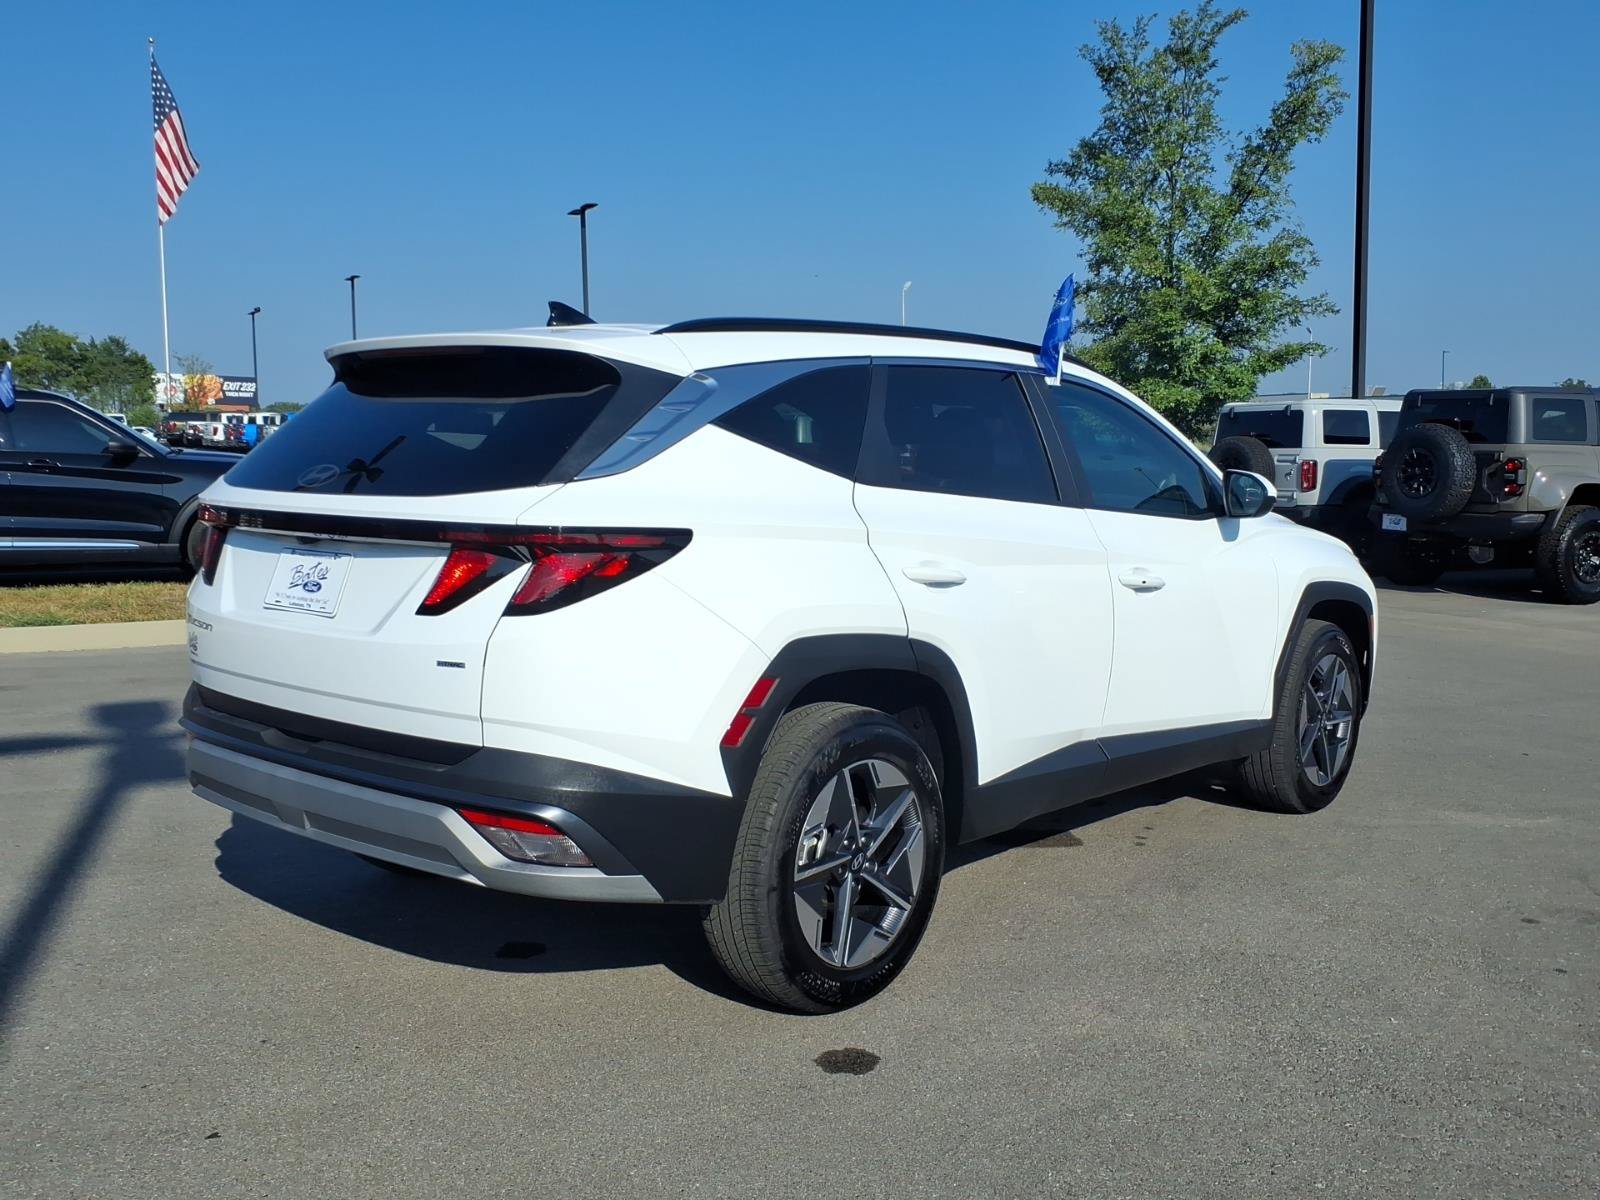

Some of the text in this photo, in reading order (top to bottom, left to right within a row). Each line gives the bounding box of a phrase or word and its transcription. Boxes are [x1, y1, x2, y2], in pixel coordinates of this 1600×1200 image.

[223, 382, 256, 392] EXIT 232
[289, 562, 330, 586] Bates
